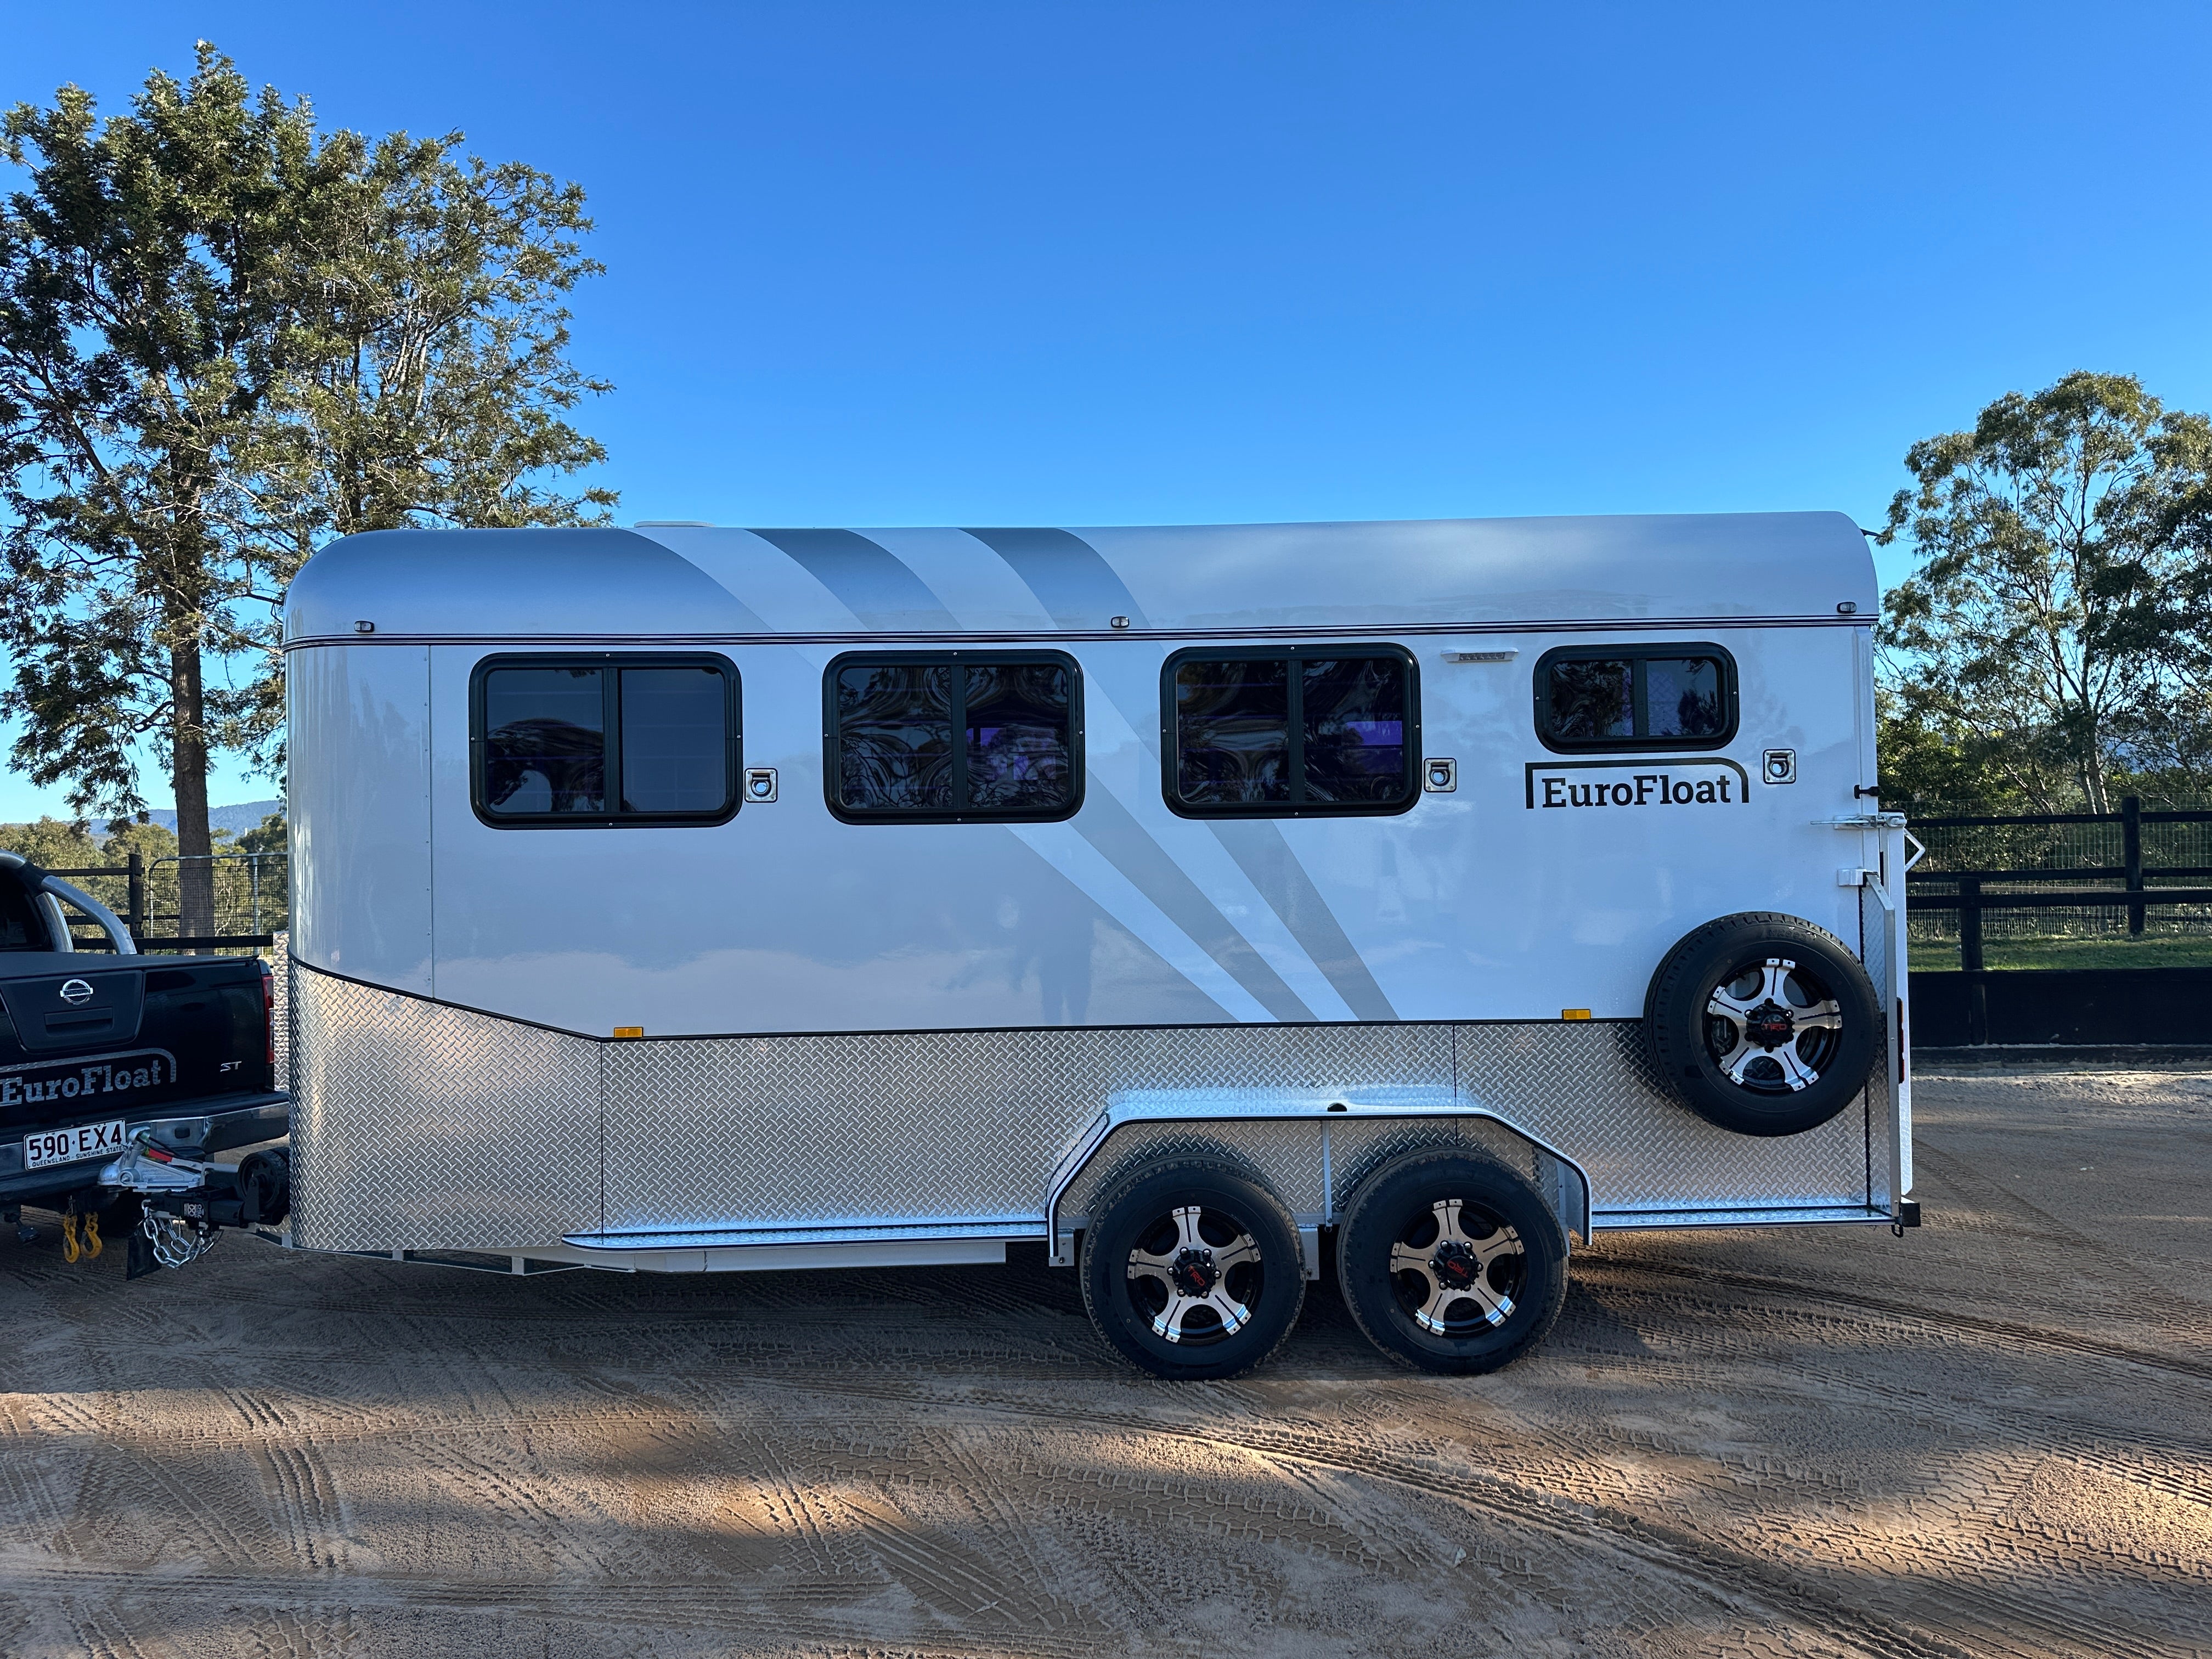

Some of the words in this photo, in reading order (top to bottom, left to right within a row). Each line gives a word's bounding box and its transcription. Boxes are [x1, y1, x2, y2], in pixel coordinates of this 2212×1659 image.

[1542, 775, 1731, 808] EuroFloat
[1764, 1023, 1787, 1031] TRD
[220, 1060, 242, 1072] ST
[0, 1060, 161, 1107] EuroFloat
[29, 1133, 69, 1161] 590
[78, 1124, 122, 1152] EX4
[32, 1155, 71, 1167] QUEENSLAND
[75, 1149, 104, 1159] SUNSHINE
[1188, 1265, 1205, 1286] TRD
[1447, 1261, 1468, 1278] TRD
